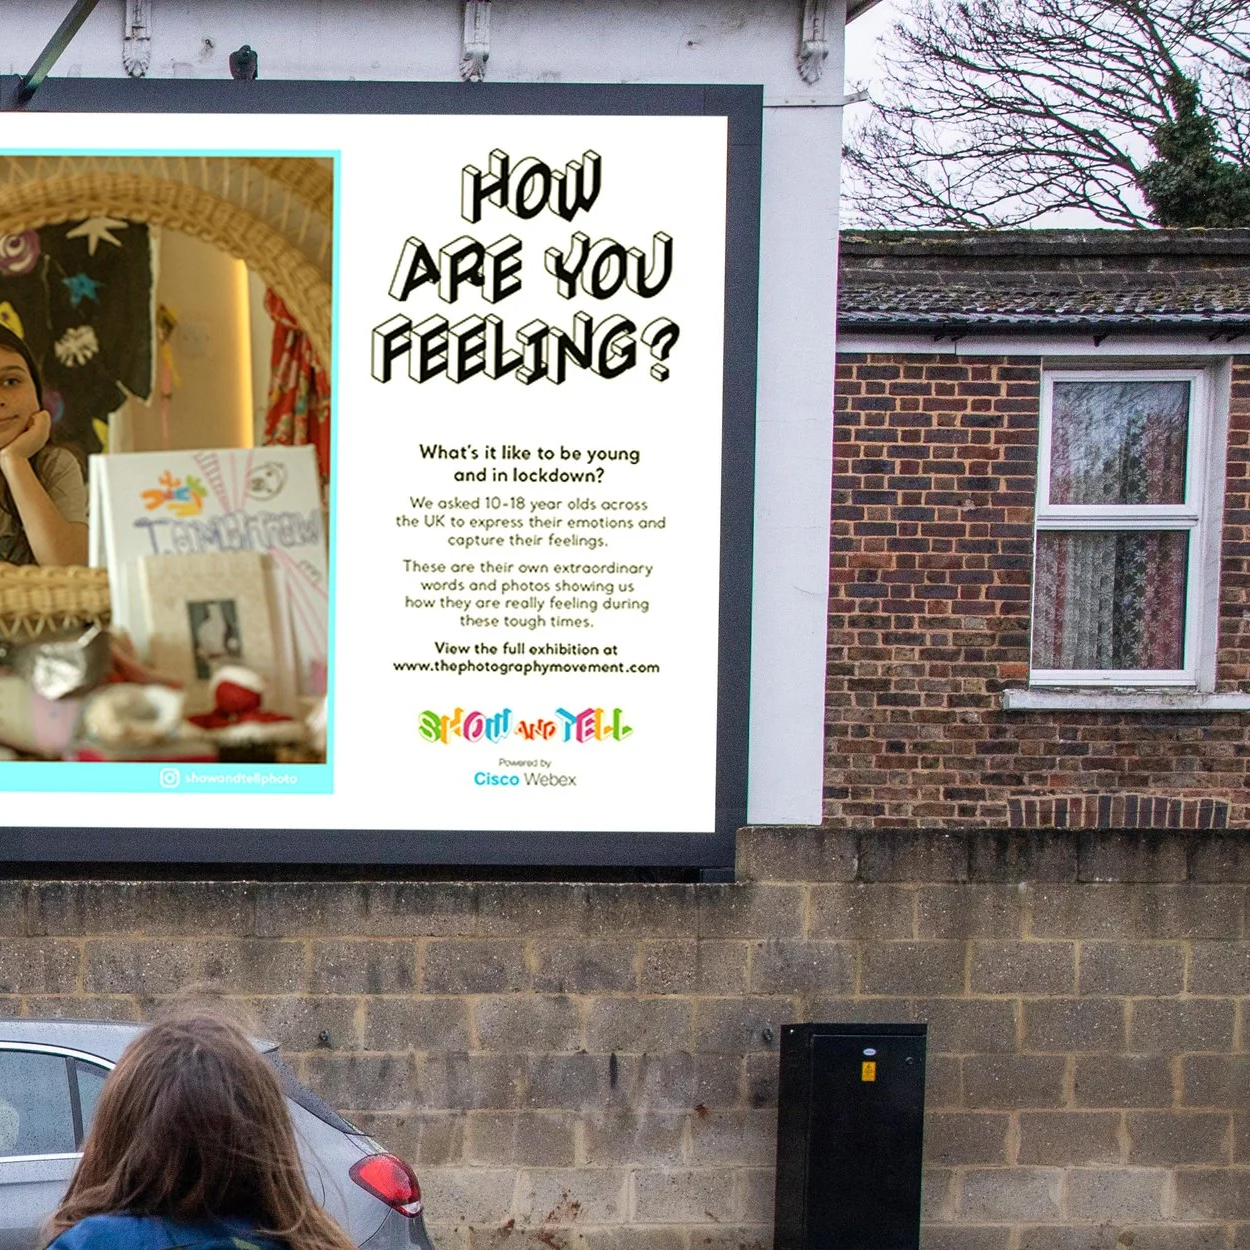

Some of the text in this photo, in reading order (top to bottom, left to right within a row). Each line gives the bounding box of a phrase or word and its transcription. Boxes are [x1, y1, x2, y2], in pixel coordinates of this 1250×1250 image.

[460, 147, 603, 225] HOW
[387, 229, 674, 306] ARE YOU
[370, 309, 681, 387] FEELING?
[484, 444, 497, 461] it
[501, 444, 532, 461] like
[536, 446, 556, 461] to
[559, 444, 582, 462] be
[586, 449, 641, 465] young
[453, 466, 606, 484] and in lockdown?
[409, 495, 649, 514] We asked 10-18 year olds across
[395, 514, 420, 528] the
[423, 513, 446, 528] UK
[469, 518, 524, 532] express
[528, 515, 563, 529] their
[566, 517, 635, 530] emotions
[637, 516, 667, 530] and
[450, 516, 466, 529] to
[447, 532, 608, 551] capture their feelings.
[402, 558, 654, 578] These are their own extraordinary
[420, 578, 635, 596] words and photos showing us
[404, 595, 650, 614] how they are really feeling during
[459, 613, 594, 631] these tough times.
[434, 641, 618, 657] View the full exhibition at
[392, 659, 661, 677] www.thephotographymovement.com
[417, 706, 634, 746] SHOW AND TELL
[498, 757, 552, 769] Powered by
[185, 771, 298, 786] showandtellphoto
[473, 771, 577, 787] Cisco Webex
